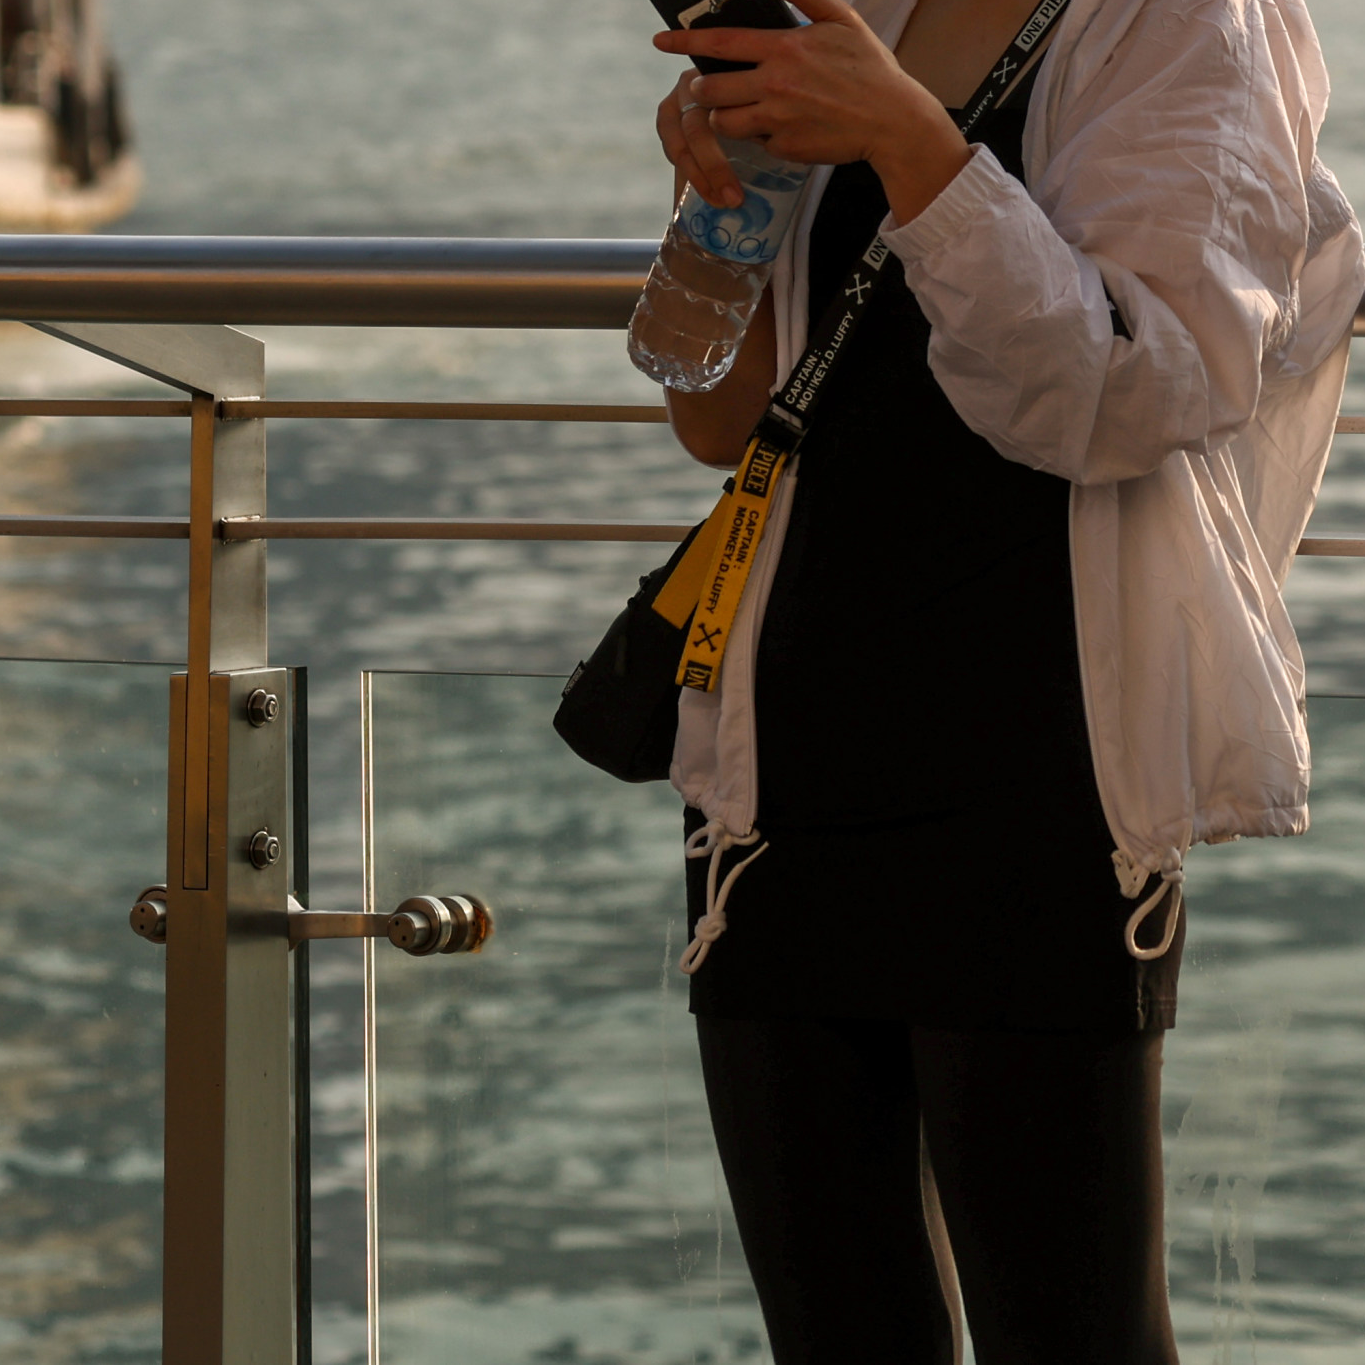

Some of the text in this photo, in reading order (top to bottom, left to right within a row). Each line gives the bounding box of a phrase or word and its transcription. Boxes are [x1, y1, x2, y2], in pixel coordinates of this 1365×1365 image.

[1020, 16, 1045, 46] ONE
[868, 236, 888, 263] ON
[746, 449, 776, 492] PIECE
